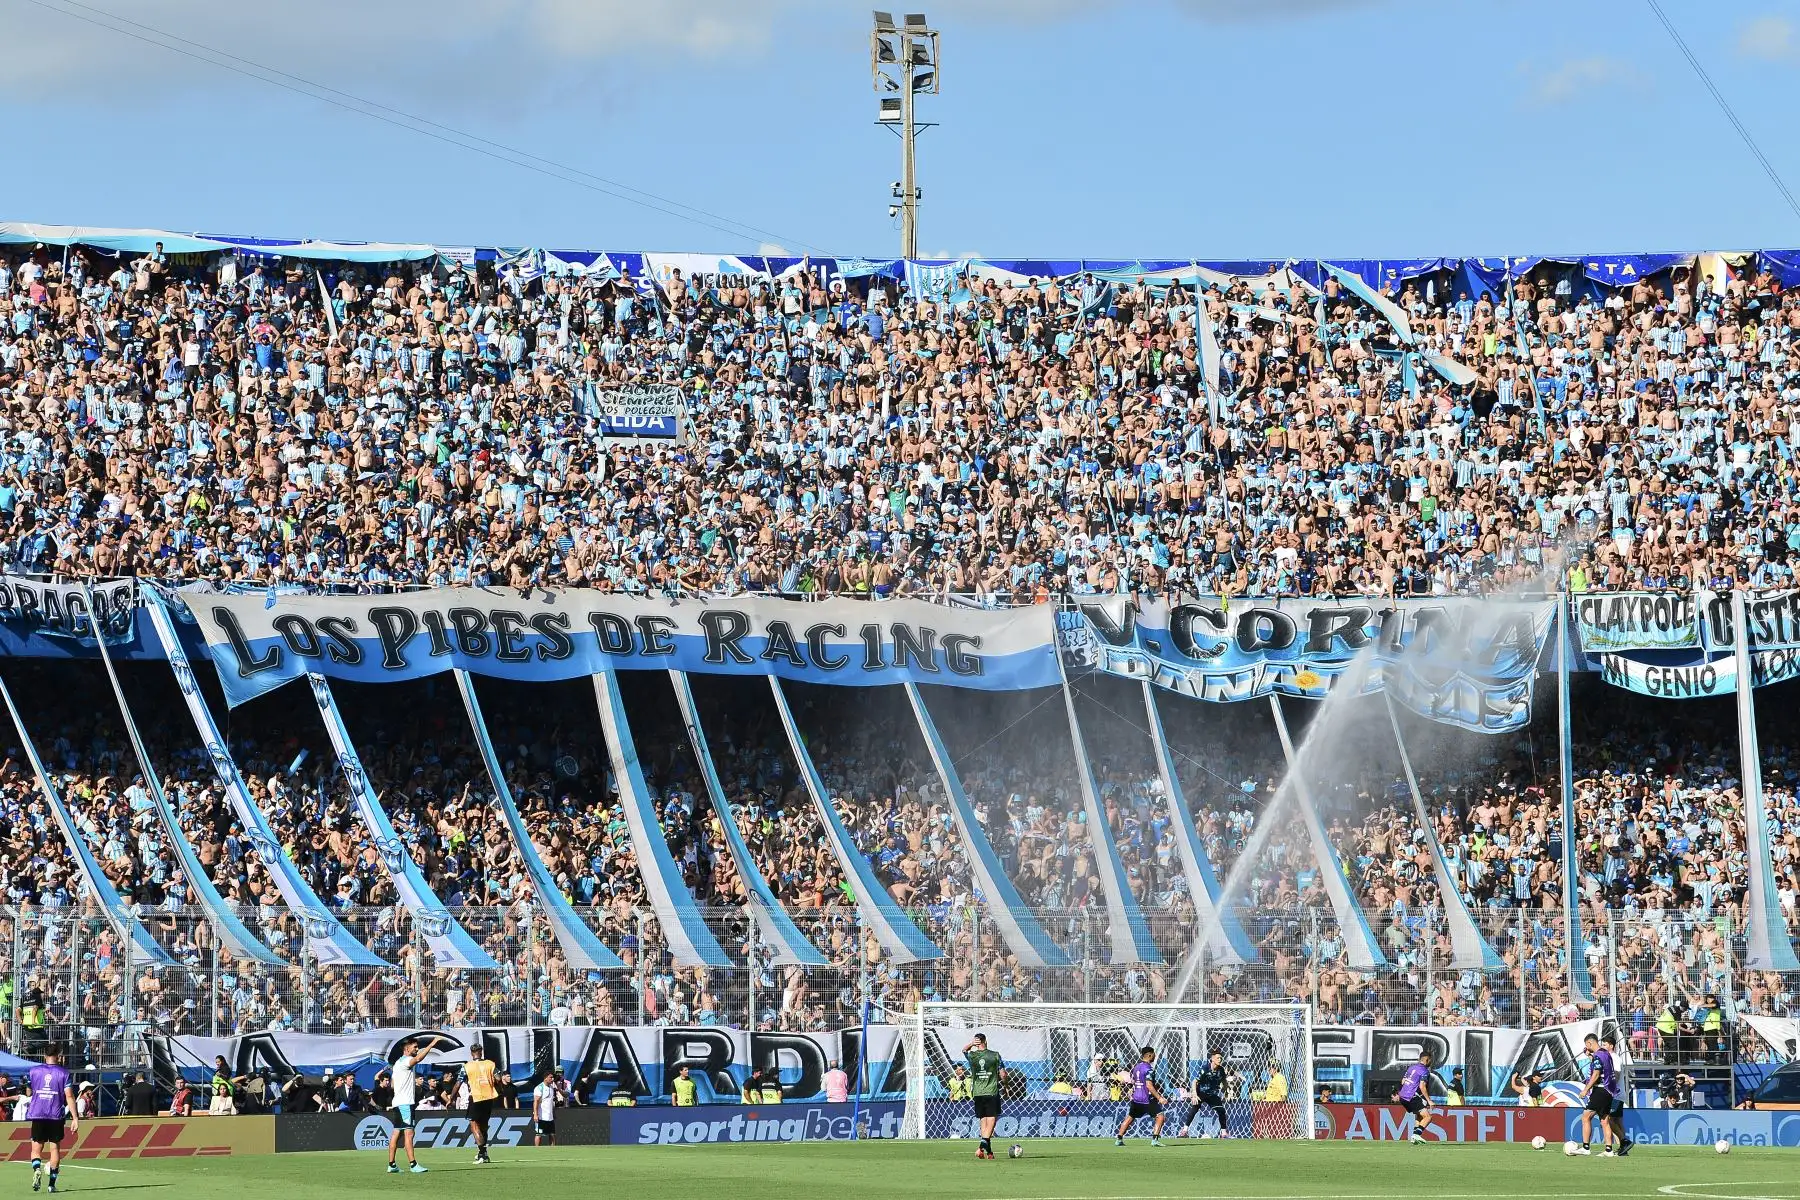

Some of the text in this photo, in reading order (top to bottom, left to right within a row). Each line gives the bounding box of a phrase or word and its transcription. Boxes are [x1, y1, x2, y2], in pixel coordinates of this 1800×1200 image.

[602, 390, 676, 407] SIEMPRE
[212, 605, 984, 680] LOS PIBES DE RACING
[1604, 651, 1630, 687] MI
[1644, 664, 1717, 696] GENIO
[8, 1124, 197, 1160] DHL
[361, 1124, 389, 1140] EA
[1697, 1126, 1766, 1147] Midea
[360, 1139, 390, 1148] SPORTS
